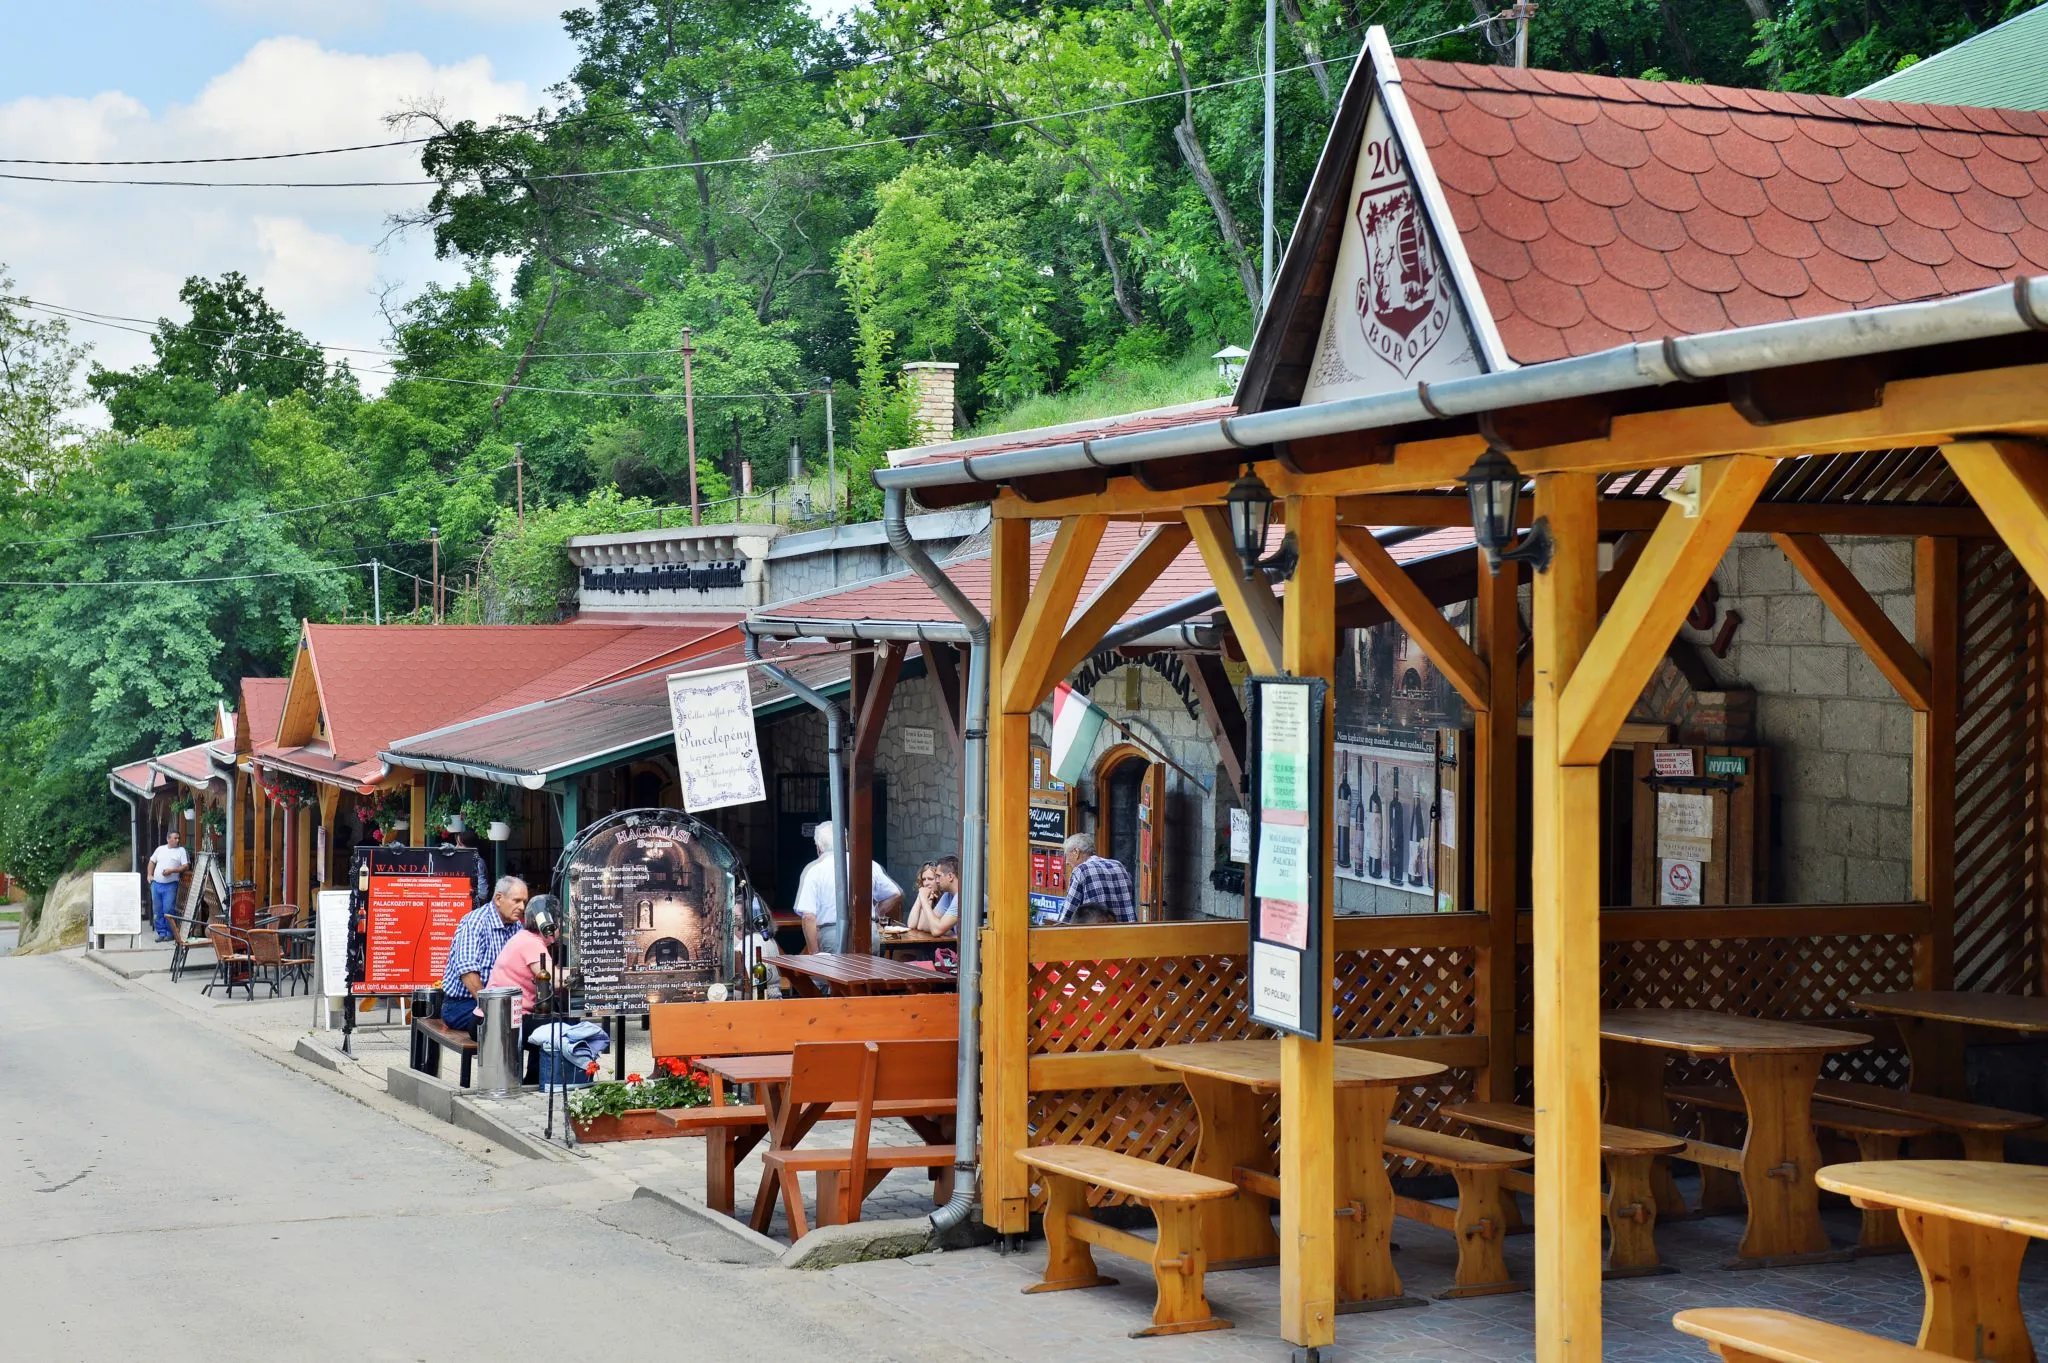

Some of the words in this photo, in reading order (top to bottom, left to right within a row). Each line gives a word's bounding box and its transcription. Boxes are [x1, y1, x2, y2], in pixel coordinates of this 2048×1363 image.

[1368, 305, 1445, 363] BOROZÓ
[680, 726, 751, 749] Pincelepény
[1337, 732, 1347, 740] Nem
[615, 825, 691, 845] HAGYMÁSI
[376, 864, 428, 873] WANDA
[580, 912, 592, 920] Egri
[580, 921, 592, 929] Egri
[593, 930, 609, 938] Syrah
[580, 939, 592, 947] Egri
